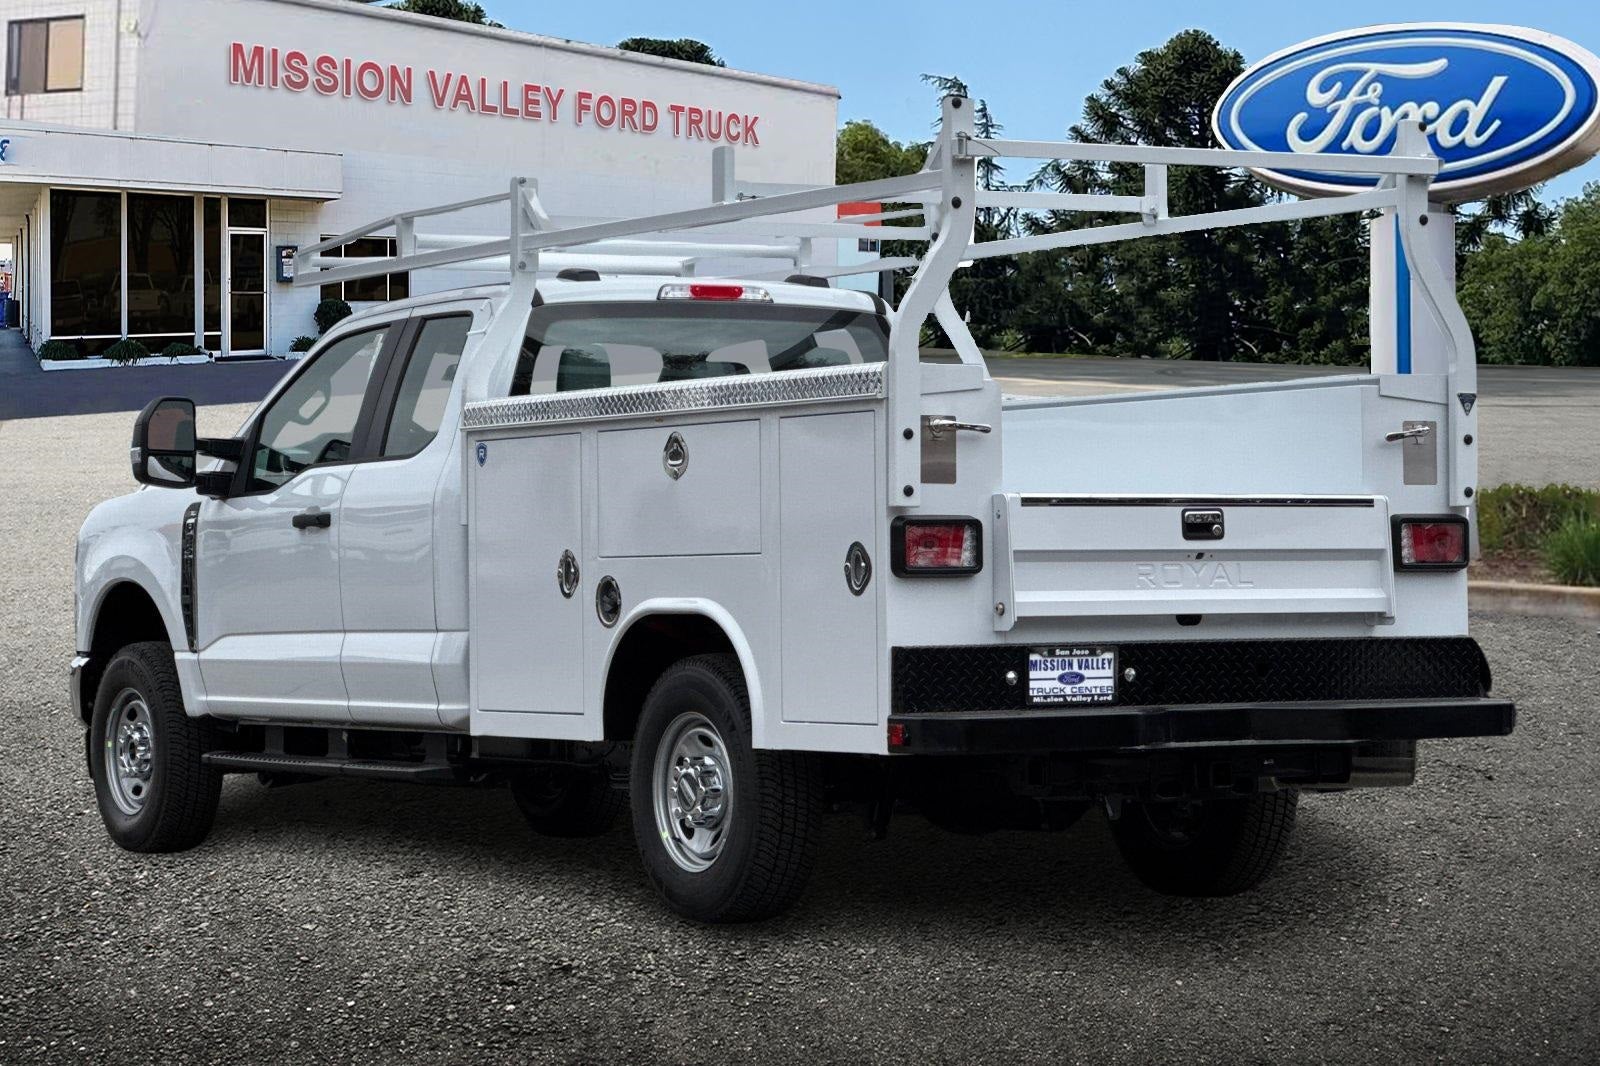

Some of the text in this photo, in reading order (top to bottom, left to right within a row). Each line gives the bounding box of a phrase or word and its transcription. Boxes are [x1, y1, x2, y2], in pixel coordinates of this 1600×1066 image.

[230, 42, 760, 146] MISSION VALLEY FORD TRUCK
[1286, 57, 1509, 154] Ford
[1135, 562, 1255, 588] ROYAL
[1055, 648, 1090, 656] San Jose
[1029, 657, 1113, 672] MISSION VALLEY
[1062, 674, 1081, 683] Ford
[1030, 685, 1114, 695] TRUCK CENTER
[1066, 695, 1092, 703] Valley
